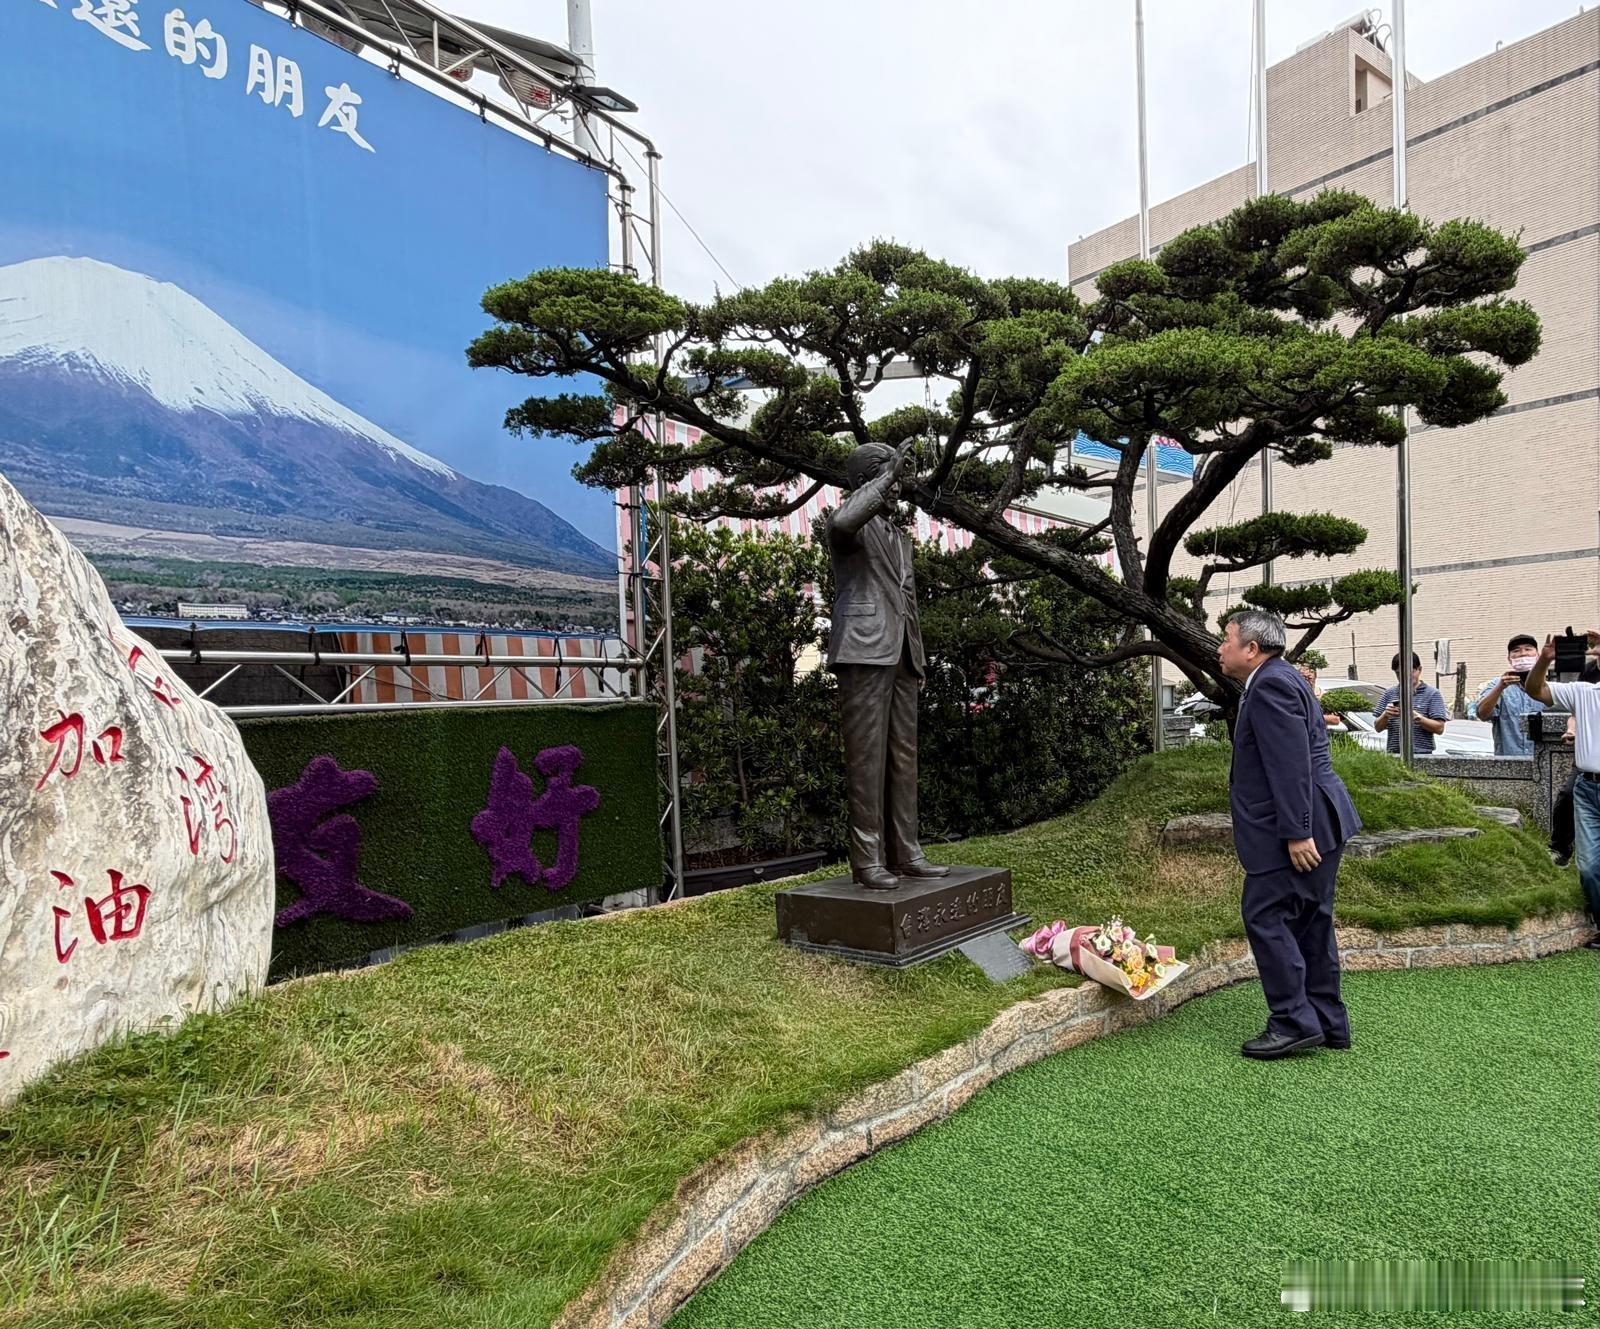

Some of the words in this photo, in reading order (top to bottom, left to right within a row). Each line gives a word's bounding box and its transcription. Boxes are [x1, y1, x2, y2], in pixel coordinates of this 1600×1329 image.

[40, 0, 376, 152] 遠的朋友
[37, 710, 152, 964] 加油
